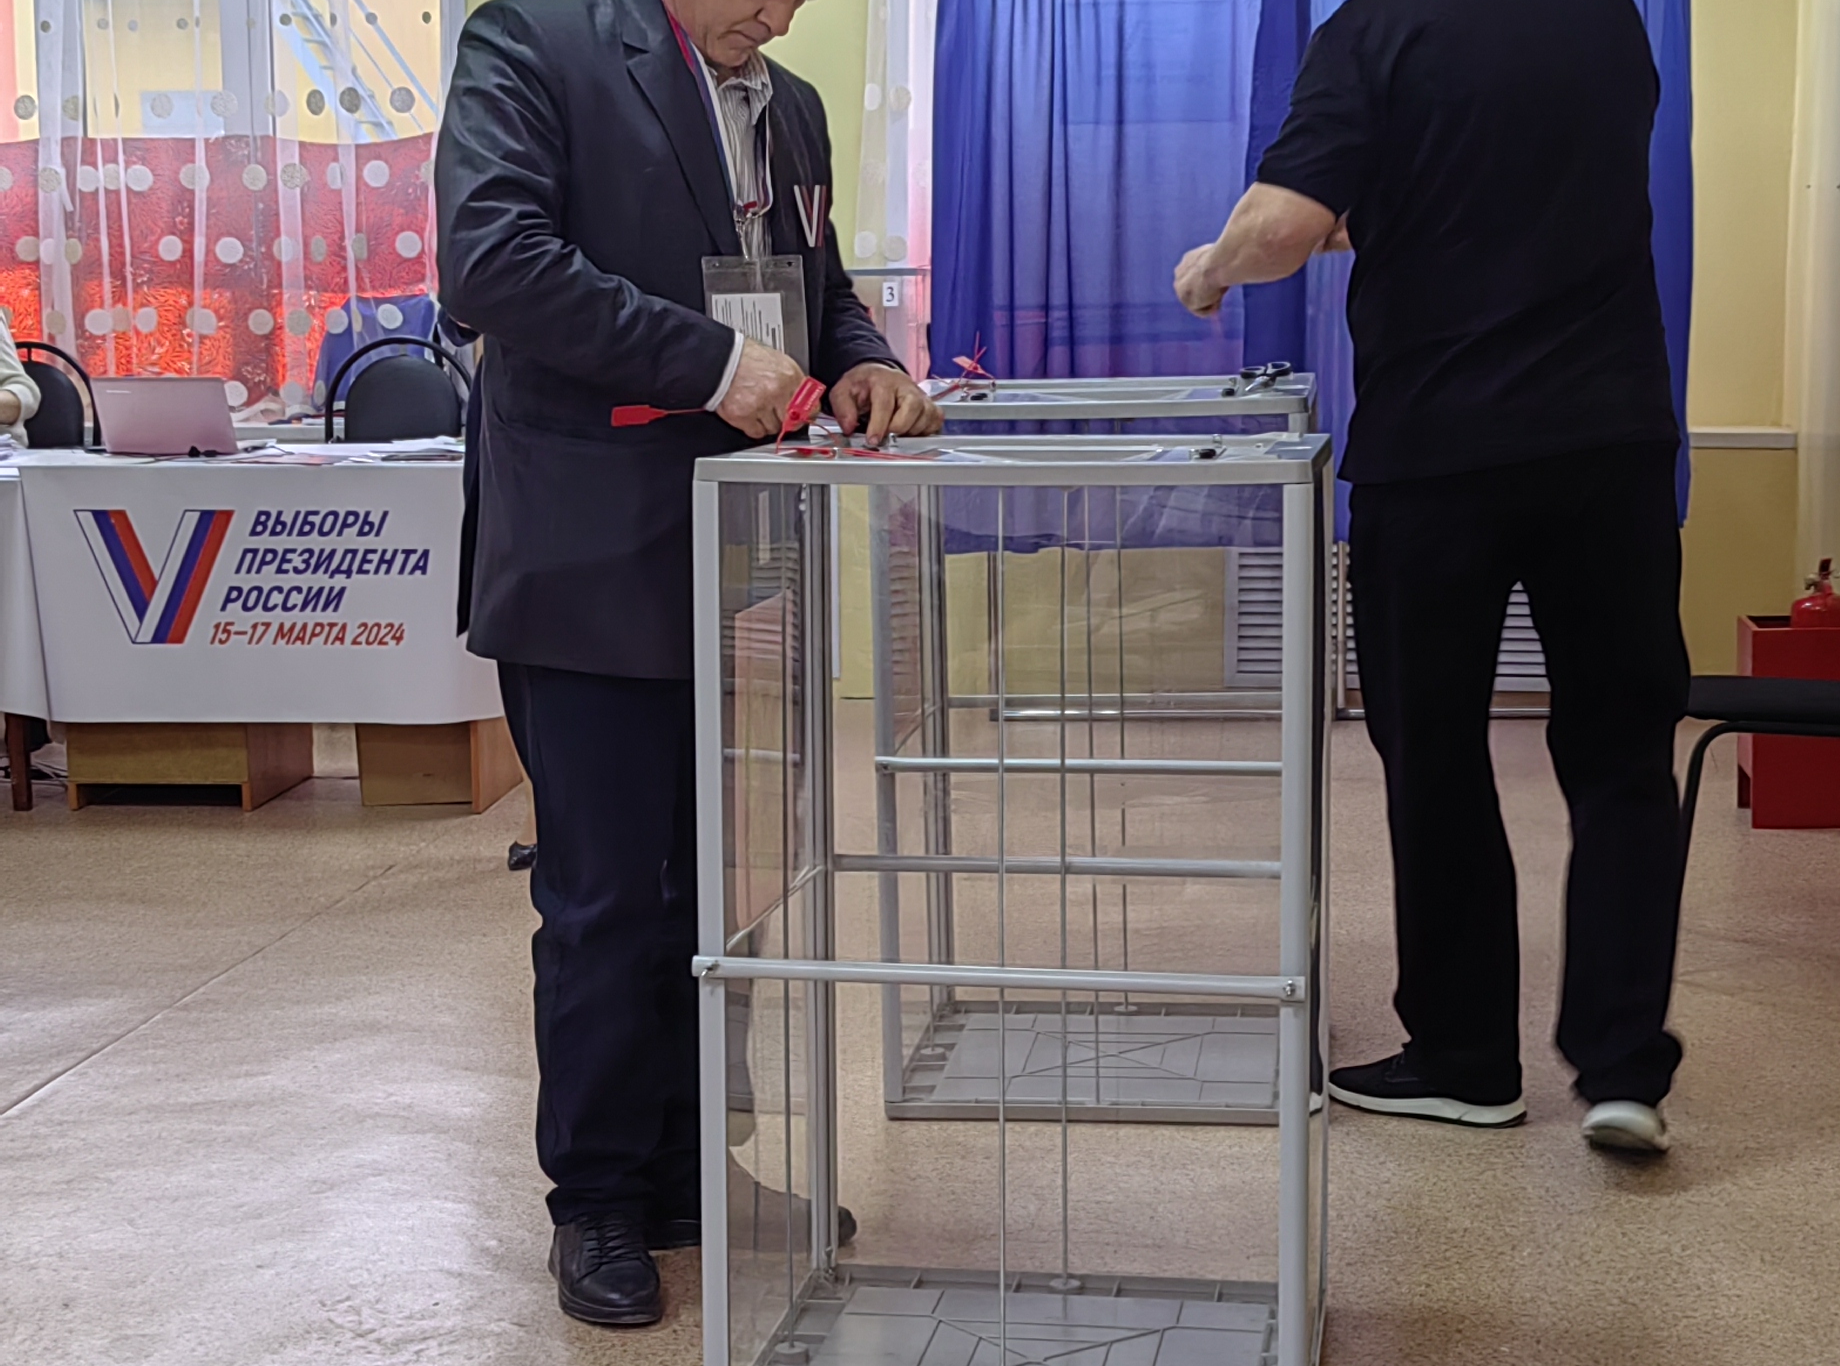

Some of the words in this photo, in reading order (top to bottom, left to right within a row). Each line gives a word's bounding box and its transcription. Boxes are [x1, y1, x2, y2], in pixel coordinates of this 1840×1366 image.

[885, 286, 895, 303] 3
[248, 510, 389, 537] ВЫБОРЫ
[234, 547, 430, 579] ПРЕЗИДЕНТА
[73, 509, 236, 645] V
[220, 585, 347, 613] РОССИИ
[272, 621, 348, 646] МАРТА
[351, 622, 406, 647] 2024
